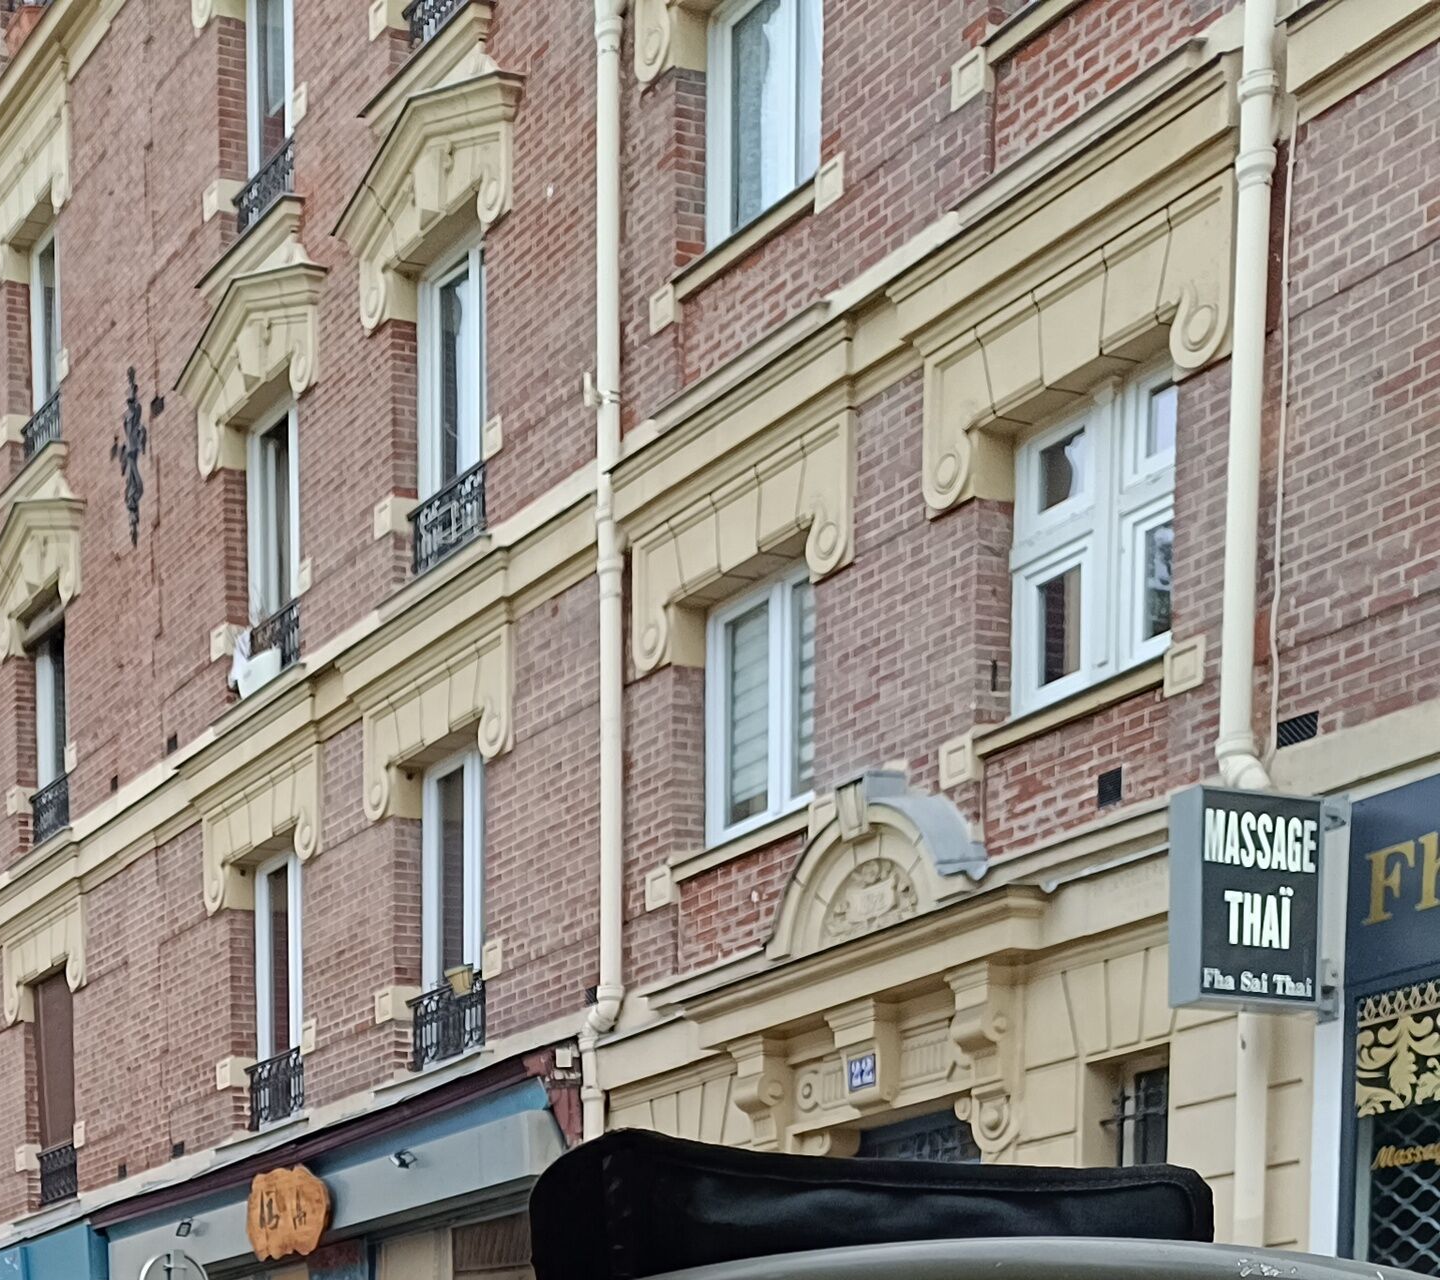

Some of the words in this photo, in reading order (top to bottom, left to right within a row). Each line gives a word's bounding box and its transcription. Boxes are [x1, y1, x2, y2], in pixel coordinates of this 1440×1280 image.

[1204, 808, 1317, 873] MASSAGE
[1224, 886, 1292, 949] THAÏ
[1203, 967, 1236, 991] Fha
[1240, 971, 1269, 994] Sai
[851, 1057, 873, 1088] 22
